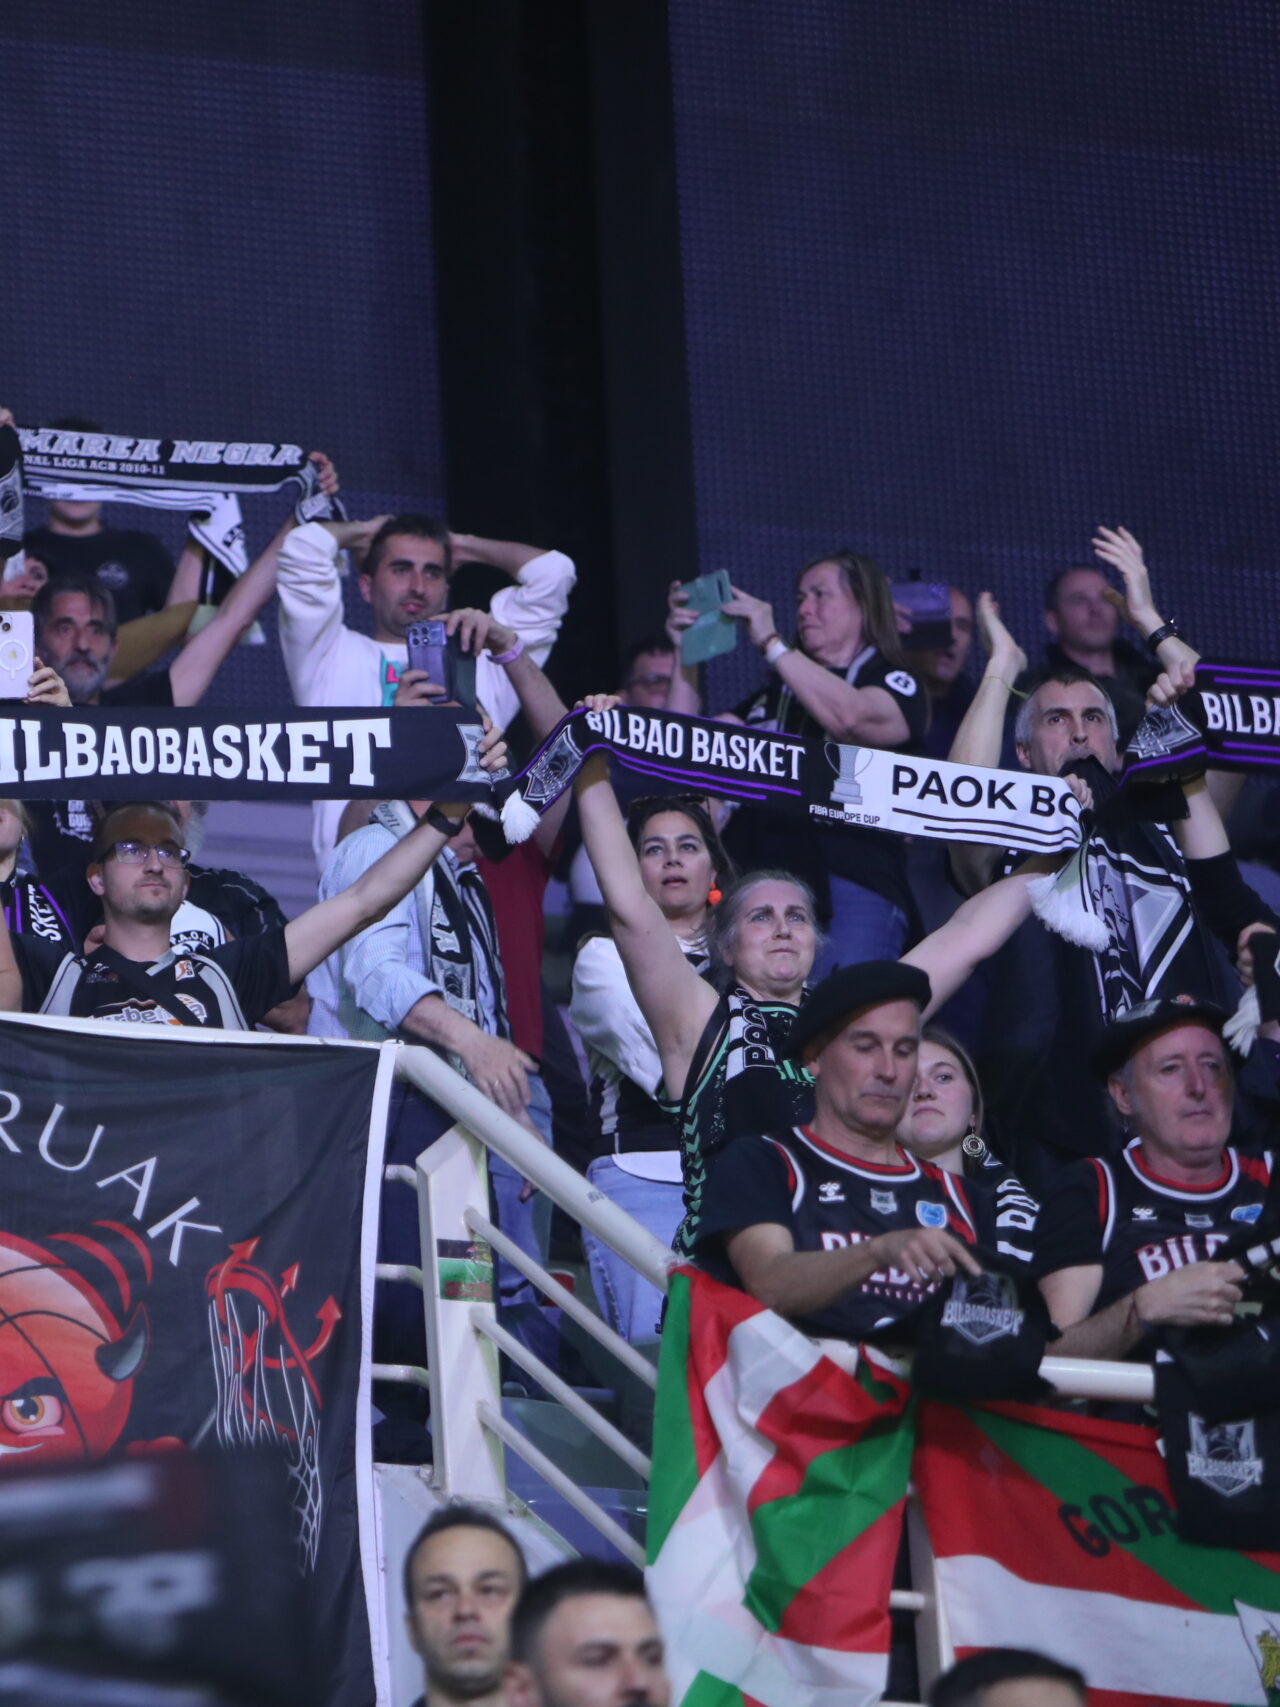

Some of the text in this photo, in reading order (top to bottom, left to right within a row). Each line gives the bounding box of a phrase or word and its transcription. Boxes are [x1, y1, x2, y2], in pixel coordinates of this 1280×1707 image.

[19, 428, 302, 466] MAREA NEGRA
[23, 454, 51, 466] NAL
[53, 456, 88, 470] LIGA
[89, 460, 118, 472] ACB
[1200, 691, 1280, 736] BILB
[585, 708, 806, 781] BILBAO BASKET
[891, 763, 1018, 812] PAOK
[809, 804, 880, 825] FIBA EUROPE CUP
[27, 884, 61, 942] SKET
[1057, 1484, 1179, 1559] GOR
